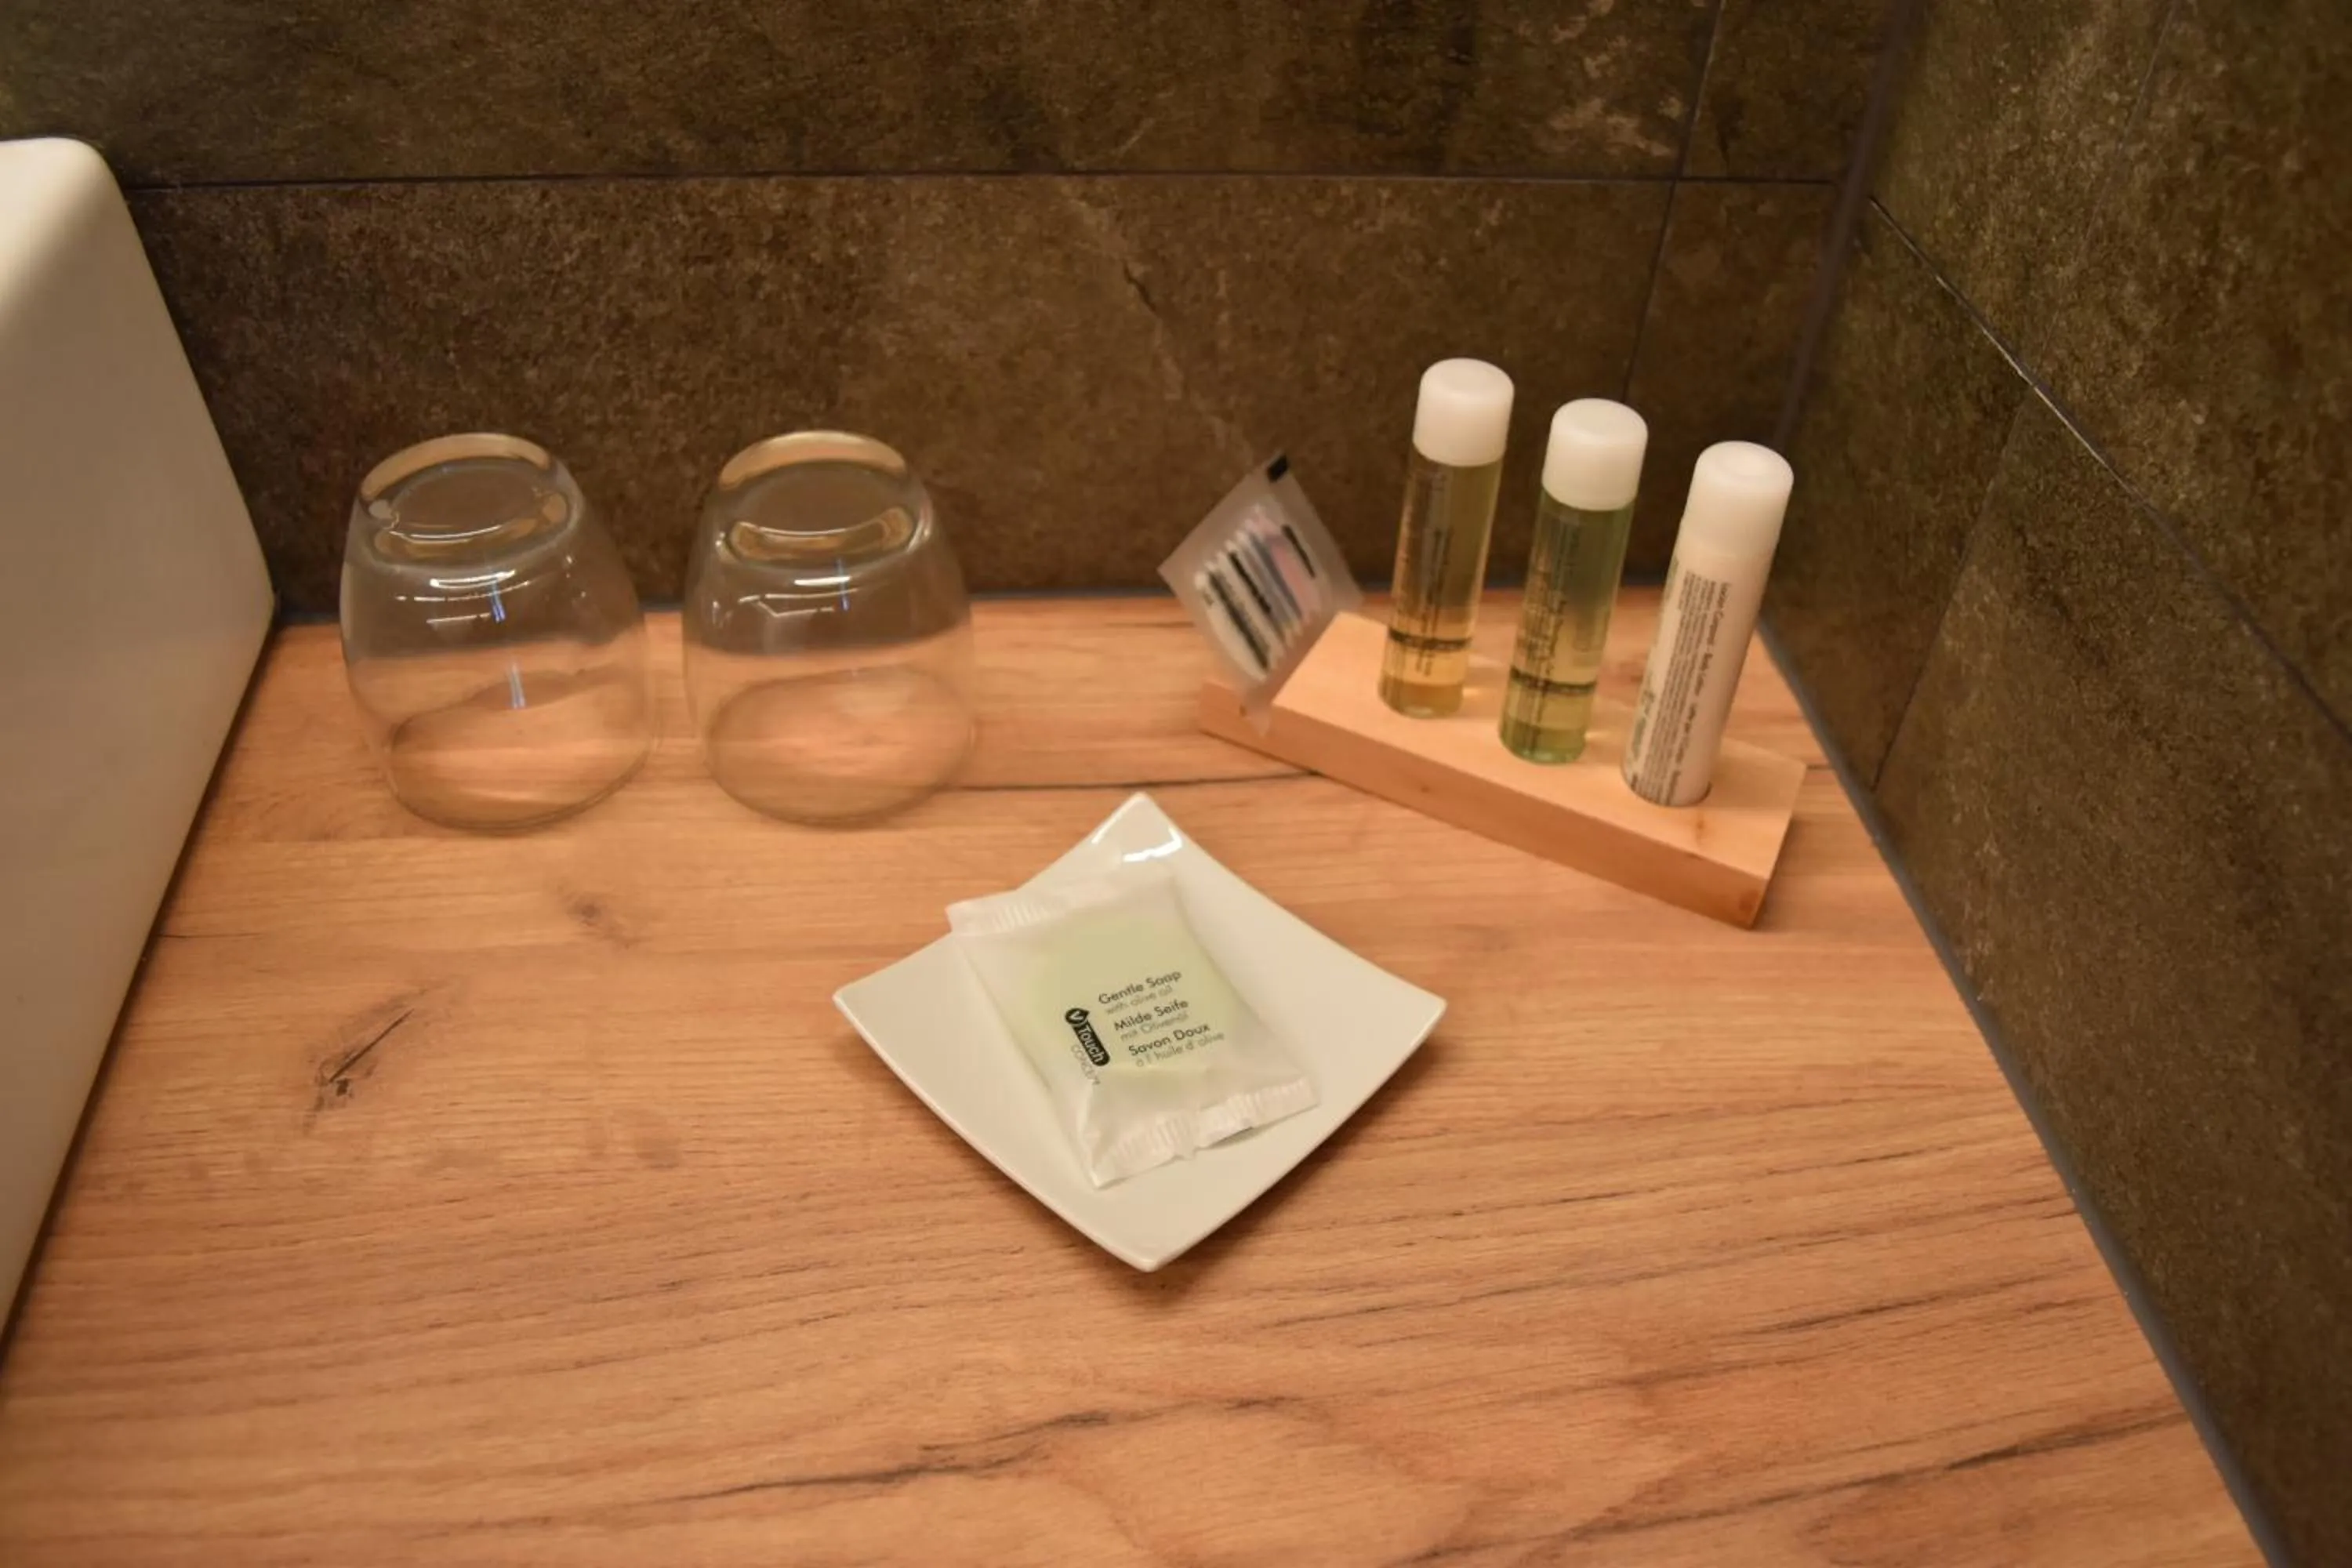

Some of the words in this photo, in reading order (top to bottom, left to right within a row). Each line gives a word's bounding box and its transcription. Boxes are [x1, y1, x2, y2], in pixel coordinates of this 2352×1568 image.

[1098, 982, 1144, 1004] Gentle
[1146, 971, 1181, 988] Soap
[1105, 1001, 1129, 1015] with
[1131, 992, 1156, 1007] olive
[1114, 1008, 1152, 1030] Milde
[1154, 998, 1189, 1017] Seife
[1078, 1028, 1105, 1062] Touch
[1129, 1036, 1171, 1056] Savon
[1173, 1024, 1210, 1041] Doux
